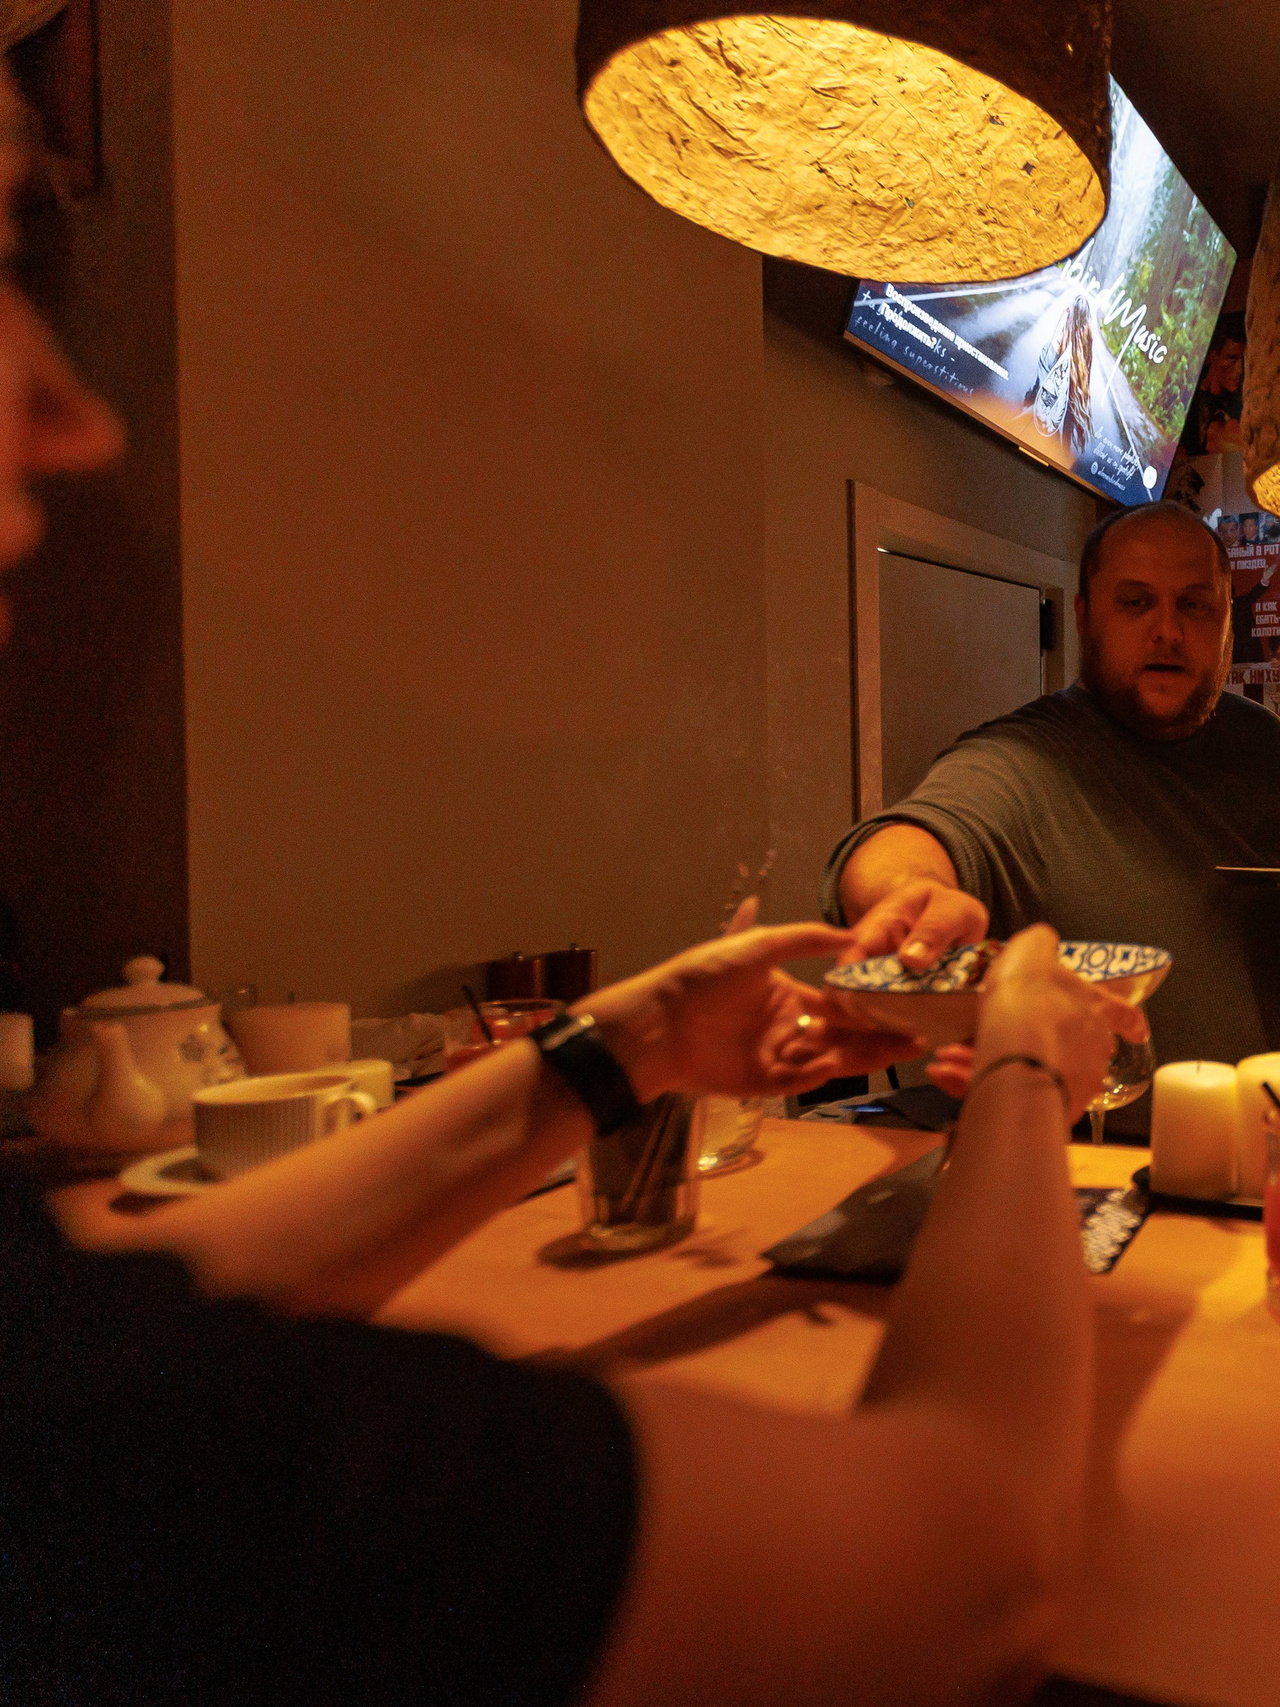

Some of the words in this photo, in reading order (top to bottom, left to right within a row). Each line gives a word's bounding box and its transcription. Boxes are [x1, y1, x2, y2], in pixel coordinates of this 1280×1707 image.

[854, 316, 898, 349] feeling
[1103, 289, 1168, 407] Music
[1263, 601, 1278, 612] КАК
